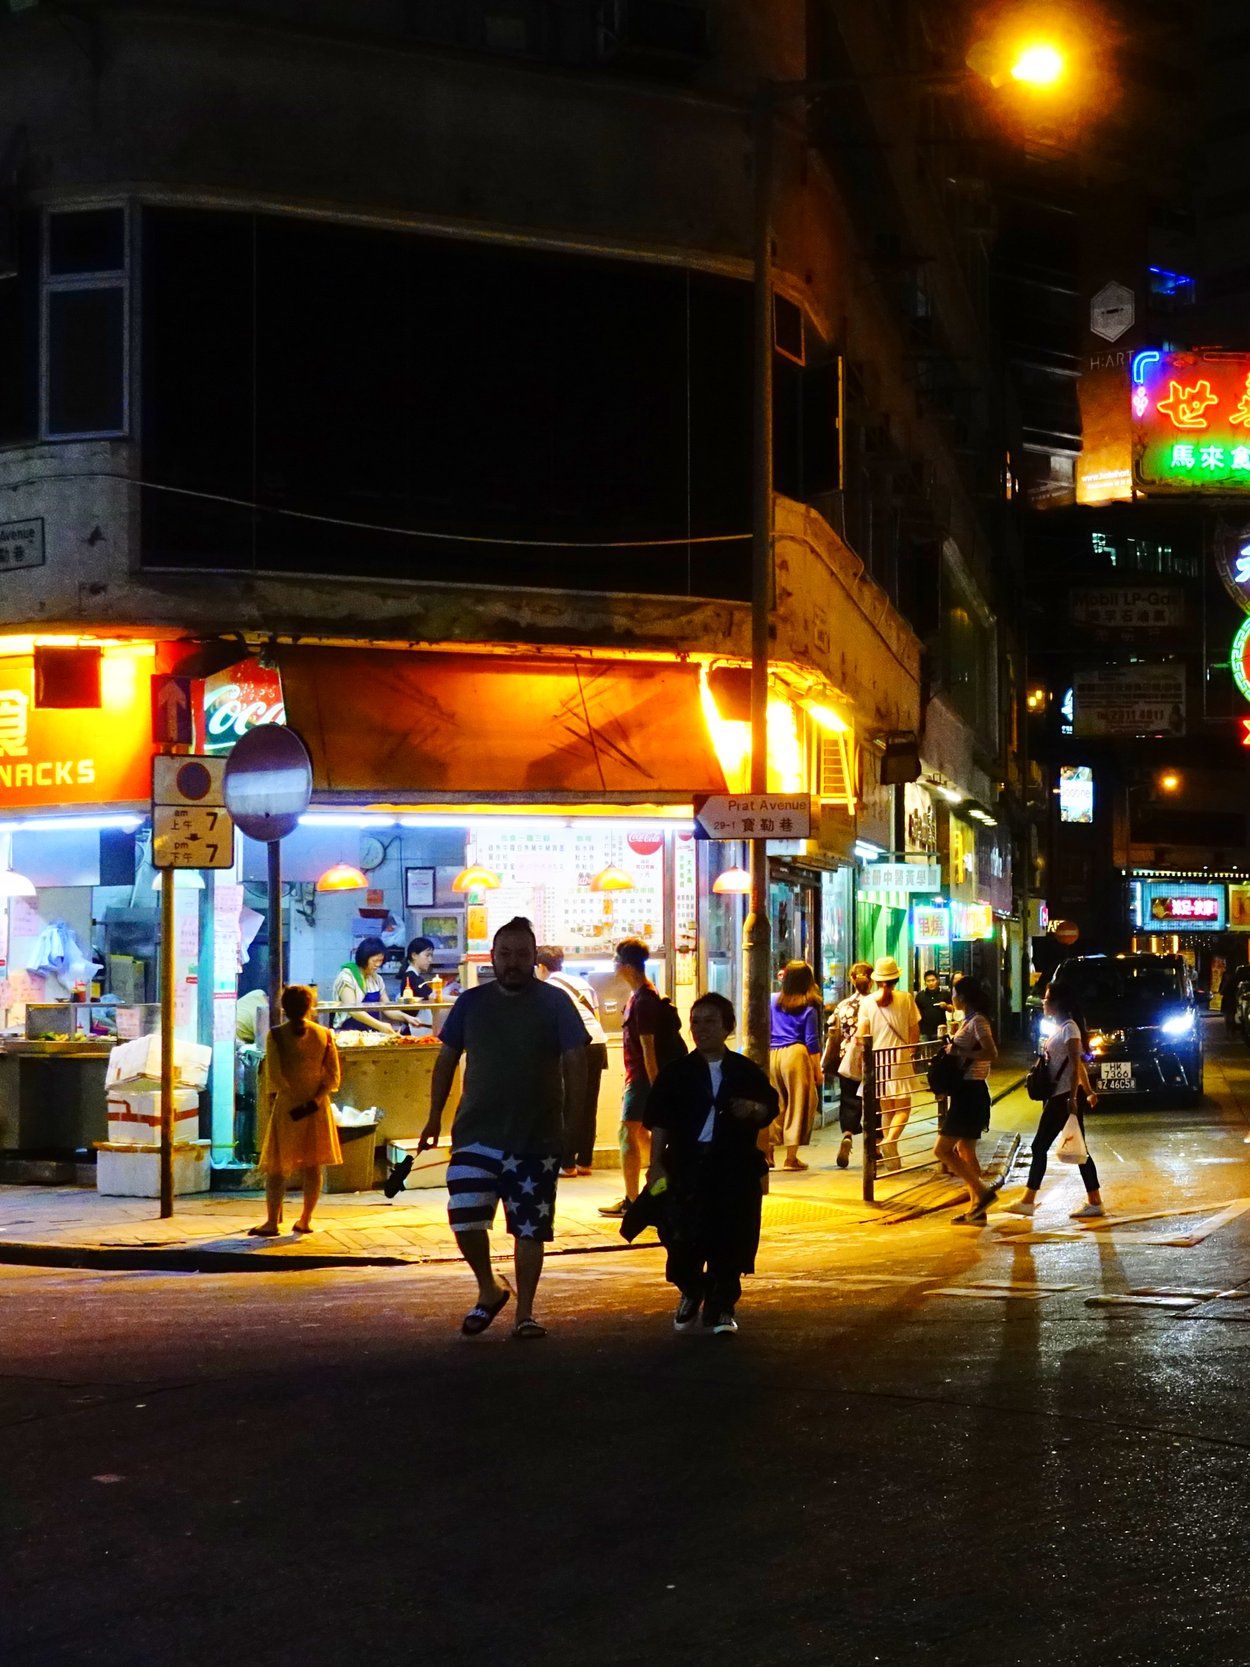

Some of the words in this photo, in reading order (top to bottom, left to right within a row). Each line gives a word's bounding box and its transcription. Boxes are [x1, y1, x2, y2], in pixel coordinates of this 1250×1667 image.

[728, 800, 755, 811] Prat
[760, 800, 807, 811] Avenue
[171, 820, 193, 831] 上午
[206, 812, 219, 832] 7
[714, 821, 735, 831] 29-1
[741, 818, 794, 833] 寶勒巷
[171, 852, 193, 864] 下午
[174, 842, 189, 850] pm
[206, 844, 219, 864] 7
[1109, 1063, 1122, 1071] HK
[1104, 1070, 1129, 1079] 7366
